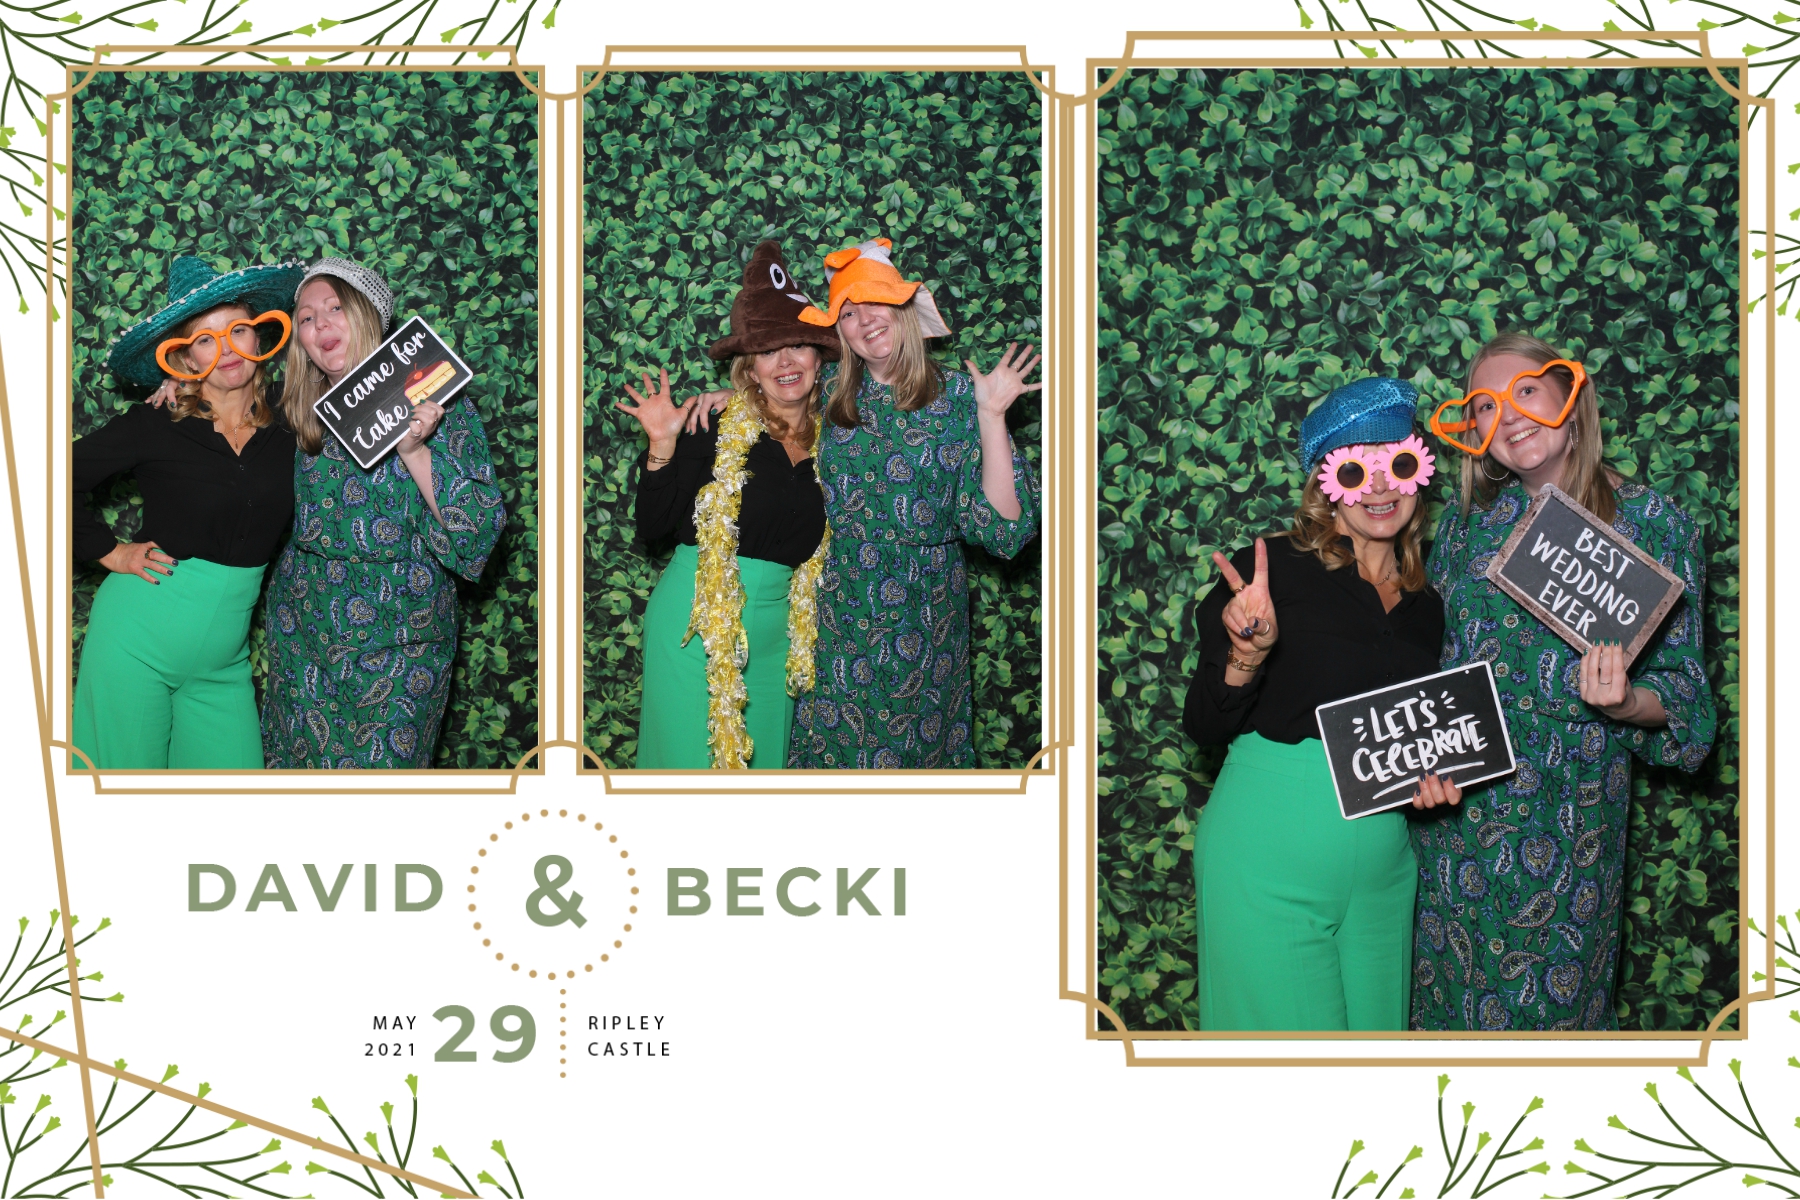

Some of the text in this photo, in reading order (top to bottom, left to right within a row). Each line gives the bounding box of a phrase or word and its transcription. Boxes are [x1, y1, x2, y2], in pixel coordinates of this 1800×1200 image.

[323, 331, 426, 421] I came for
[353, 404, 409, 449] Cake
[1530, 532, 1640, 625] WEDDING
[1574, 527, 1635, 580] BEST
[1538, 579, 1597, 637] EVER
[1369, 690, 1438, 743] LET'S
[1352, 714, 1488, 782] CELEBRATE
